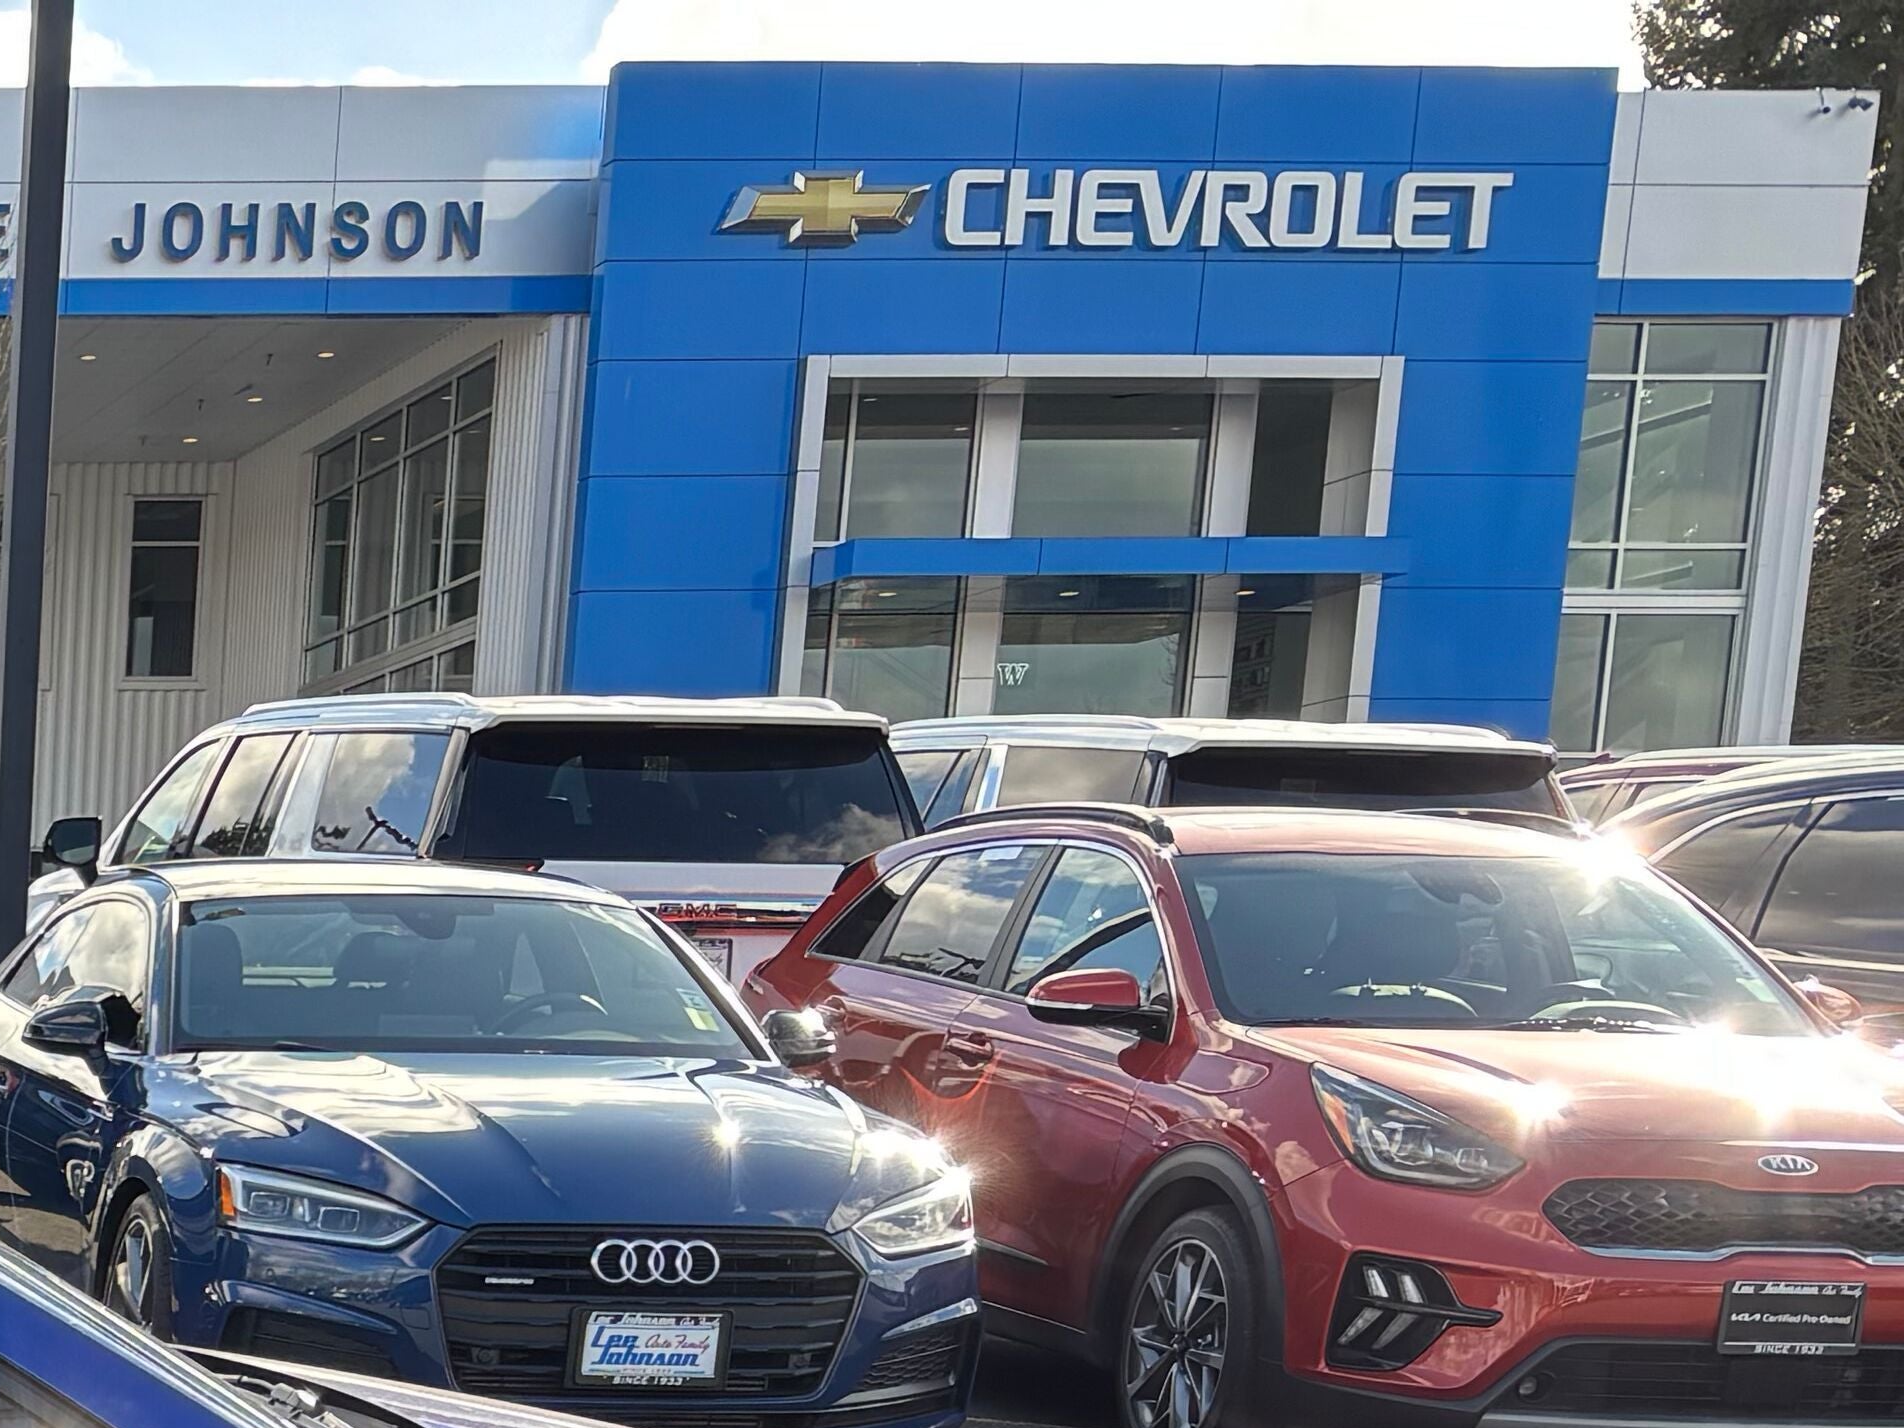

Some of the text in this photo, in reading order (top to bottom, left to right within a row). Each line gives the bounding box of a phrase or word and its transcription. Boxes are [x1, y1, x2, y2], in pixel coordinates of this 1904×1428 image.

[944, 169, 1514, 250] CHEVROLET
[111, 200, 484, 262] JOHNSON
[656, 903, 737, 918] GMC
[1762, 1313, 1802, 1324] Certified
[590, 1325, 639, 1348] Lee
[590, 1345, 700, 1367] Johnson
